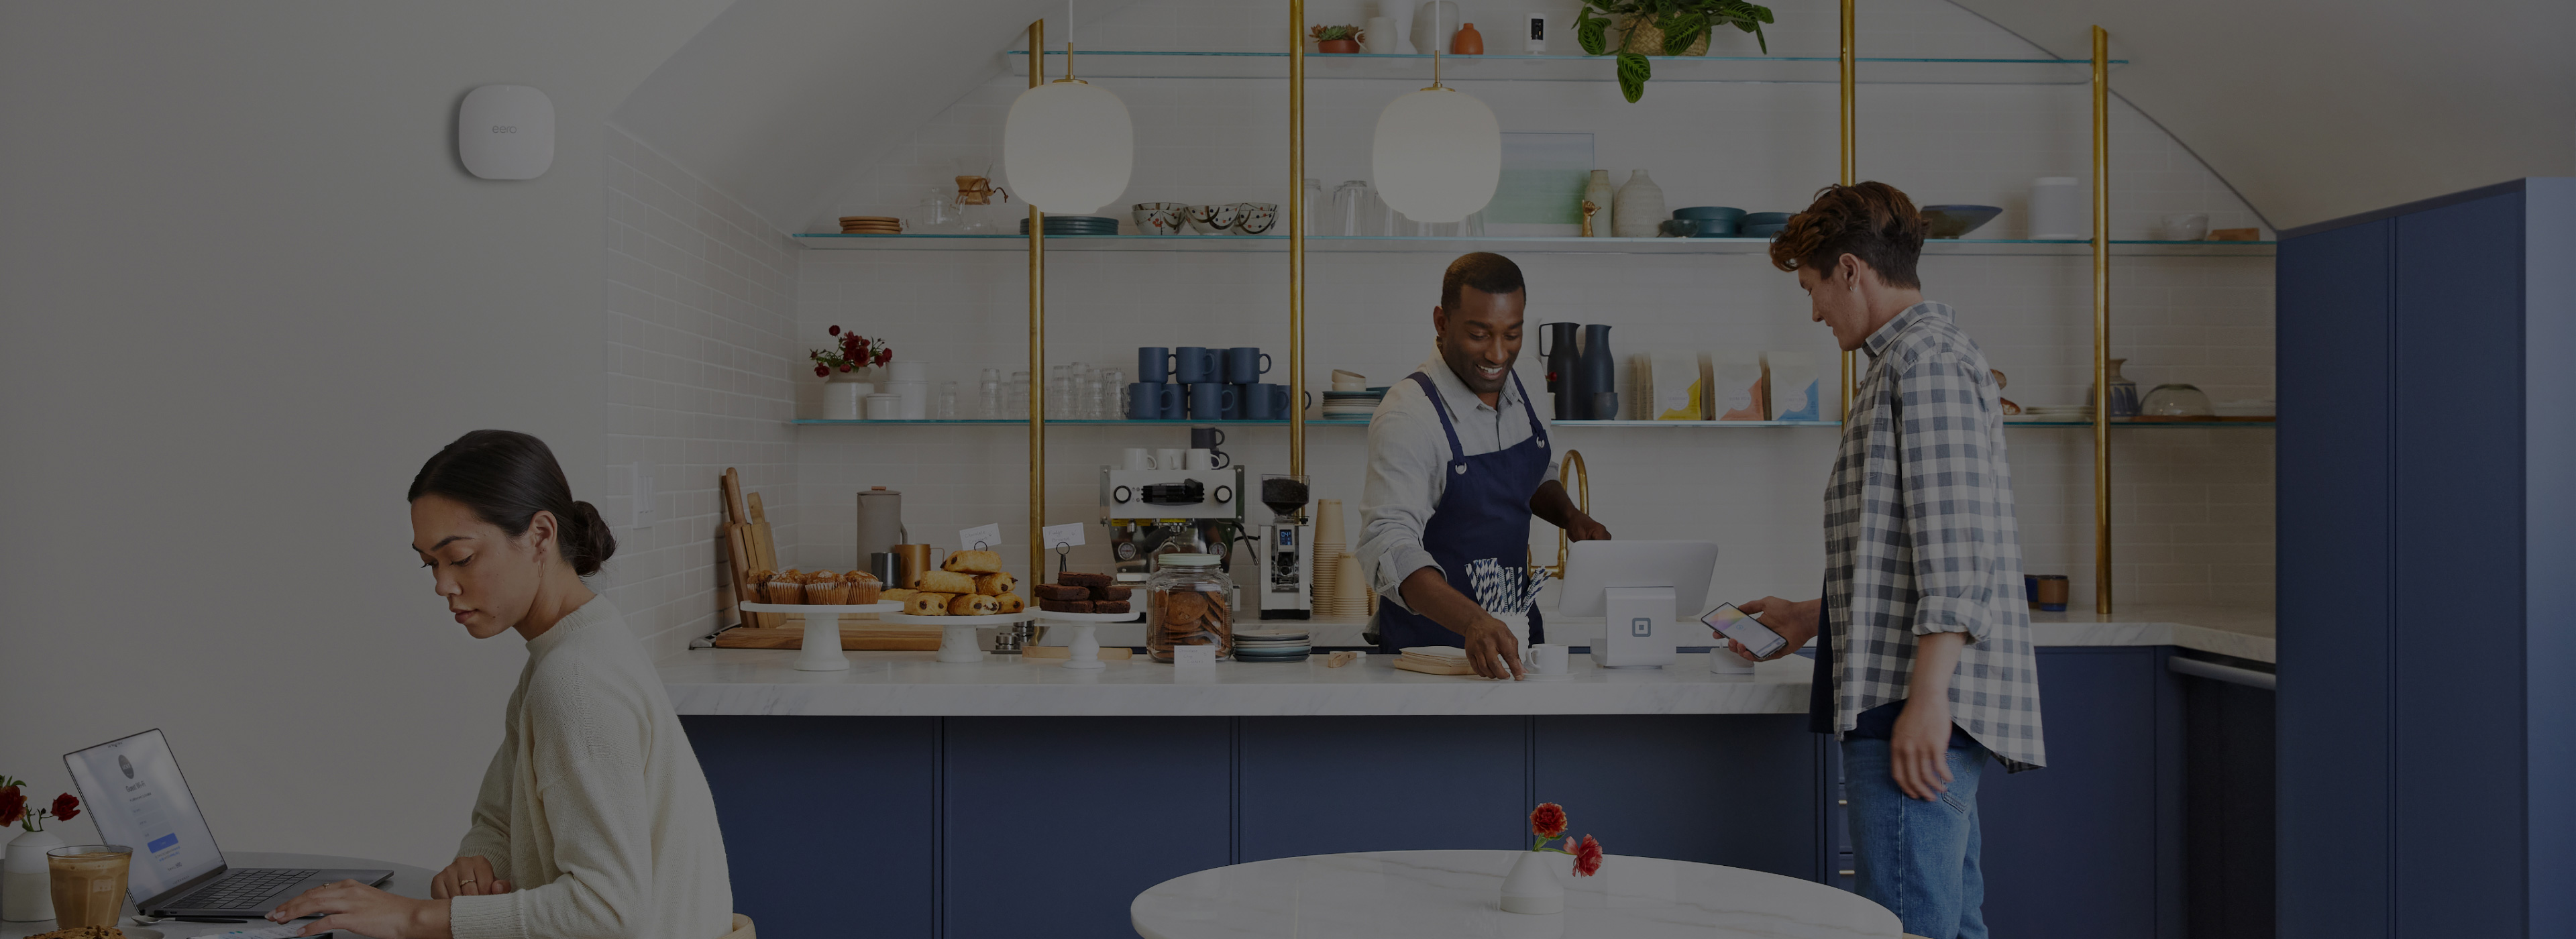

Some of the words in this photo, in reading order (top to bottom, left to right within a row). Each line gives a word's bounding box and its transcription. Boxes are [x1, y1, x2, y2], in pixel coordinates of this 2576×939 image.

[492, 125, 517, 133] eero
[1049, 530, 1063, 538] Fudge
[125, 784, 138, 793] Guest
[135, 780, 146, 789] Wi-Fi
